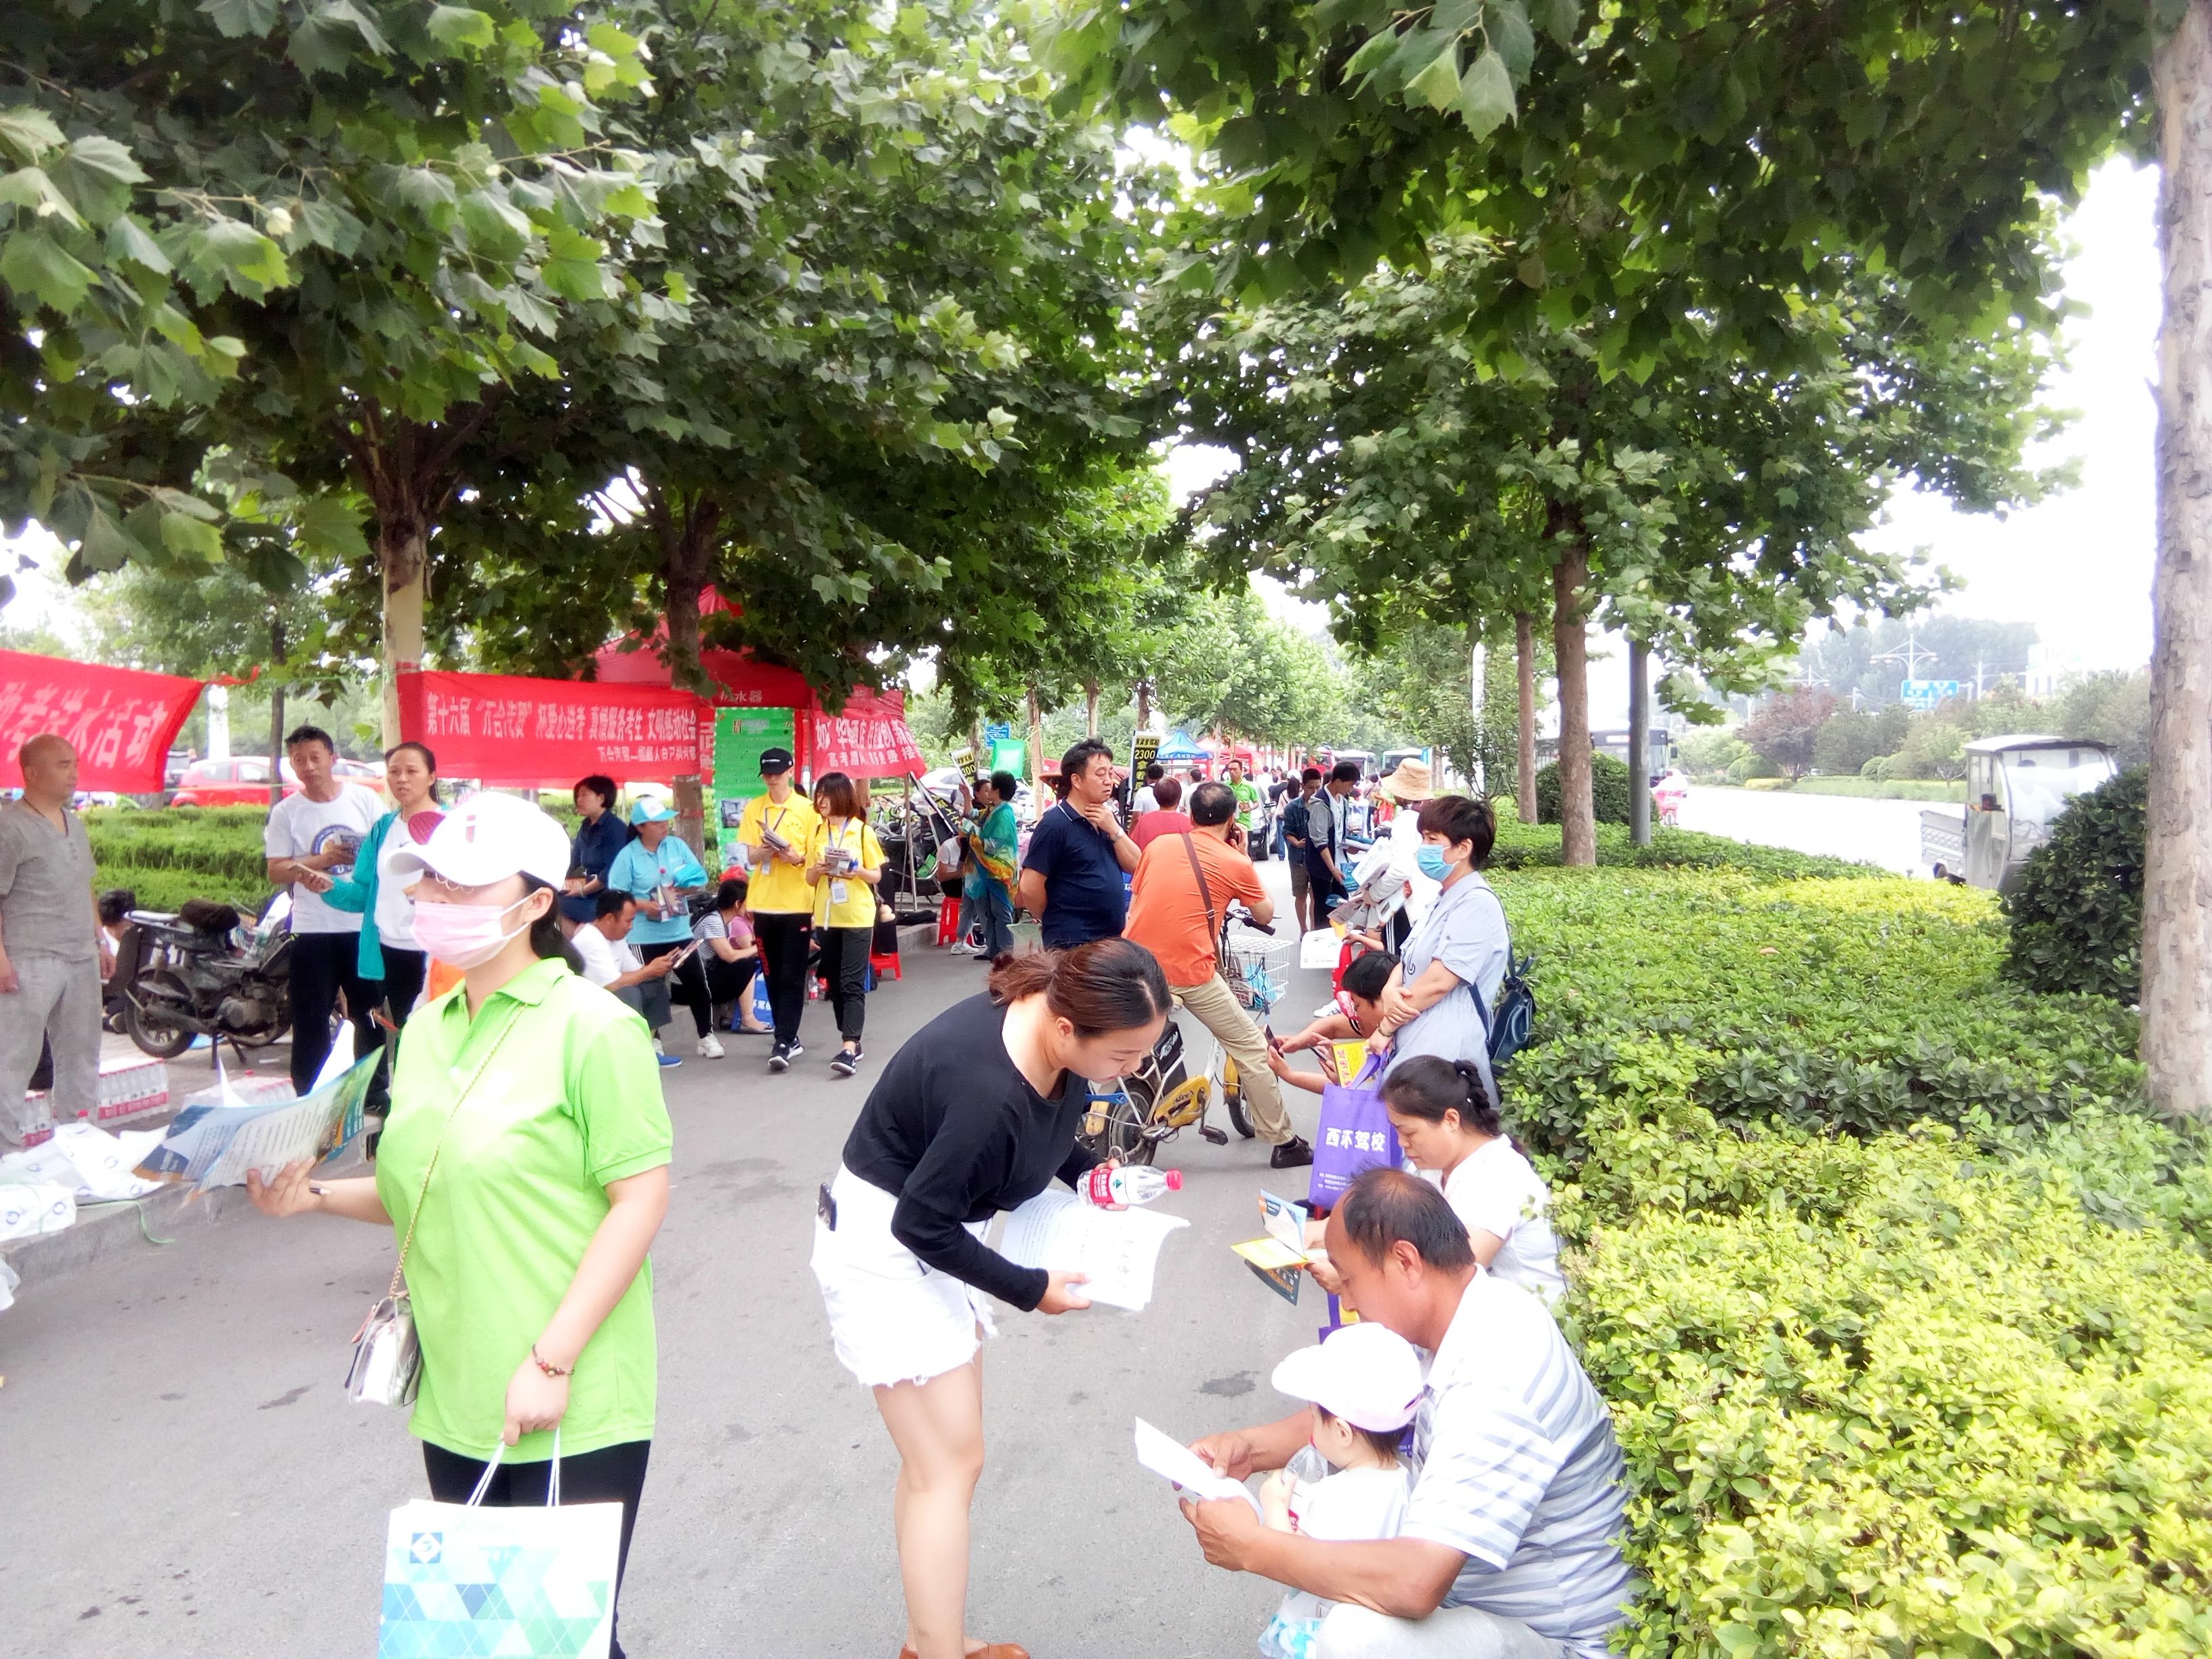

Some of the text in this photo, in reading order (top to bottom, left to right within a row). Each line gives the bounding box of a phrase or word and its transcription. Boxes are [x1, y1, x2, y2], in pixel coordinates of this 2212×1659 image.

[427, 691, 472, 737] 第十六届
[536, 702, 586, 741] 杯爱心送考
[588, 705, 643, 742] 真情服务考生
[647, 706, 697, 741] 文明感动社会
[1134, 749, 1156, 760] 2300
